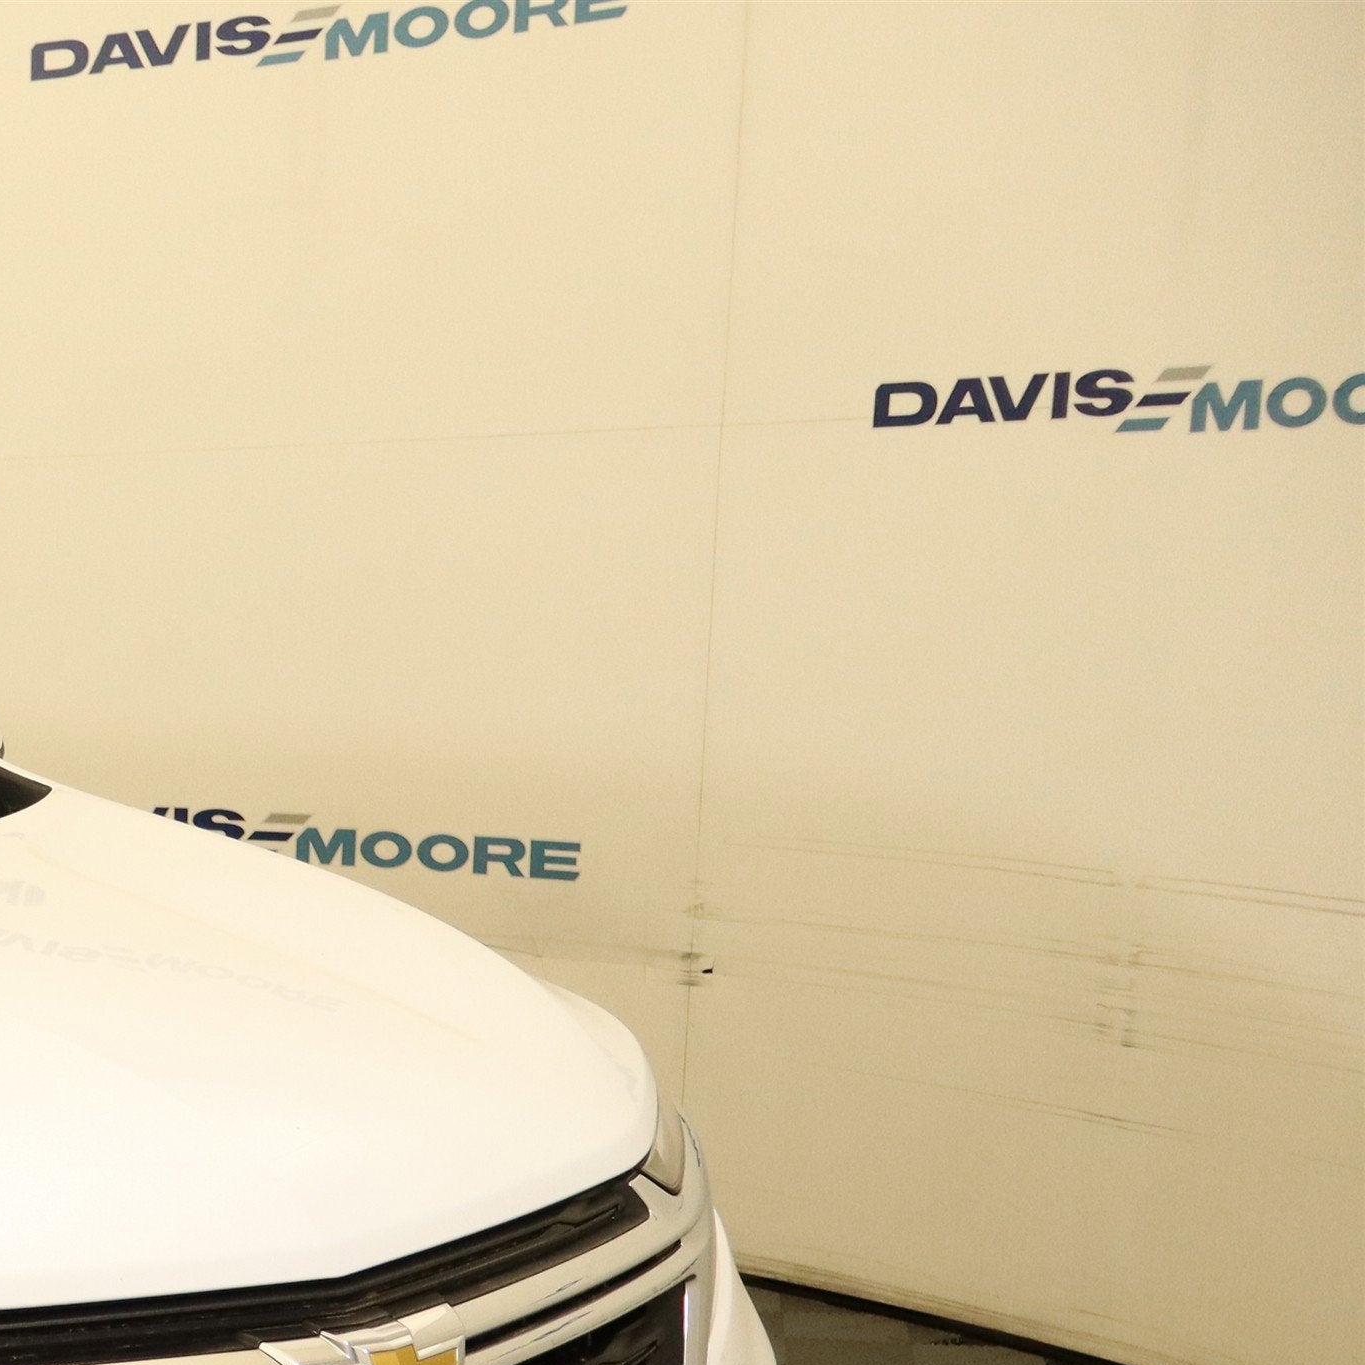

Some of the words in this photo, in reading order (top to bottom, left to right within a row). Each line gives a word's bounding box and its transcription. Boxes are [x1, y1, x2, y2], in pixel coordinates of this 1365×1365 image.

[30, 15, 271, 82] DAVIS
[872, 369, 1135, 429] DAVIS
[1189, 372, 1365, 433] MOO
[295, 827, 582, 882] MOORE
